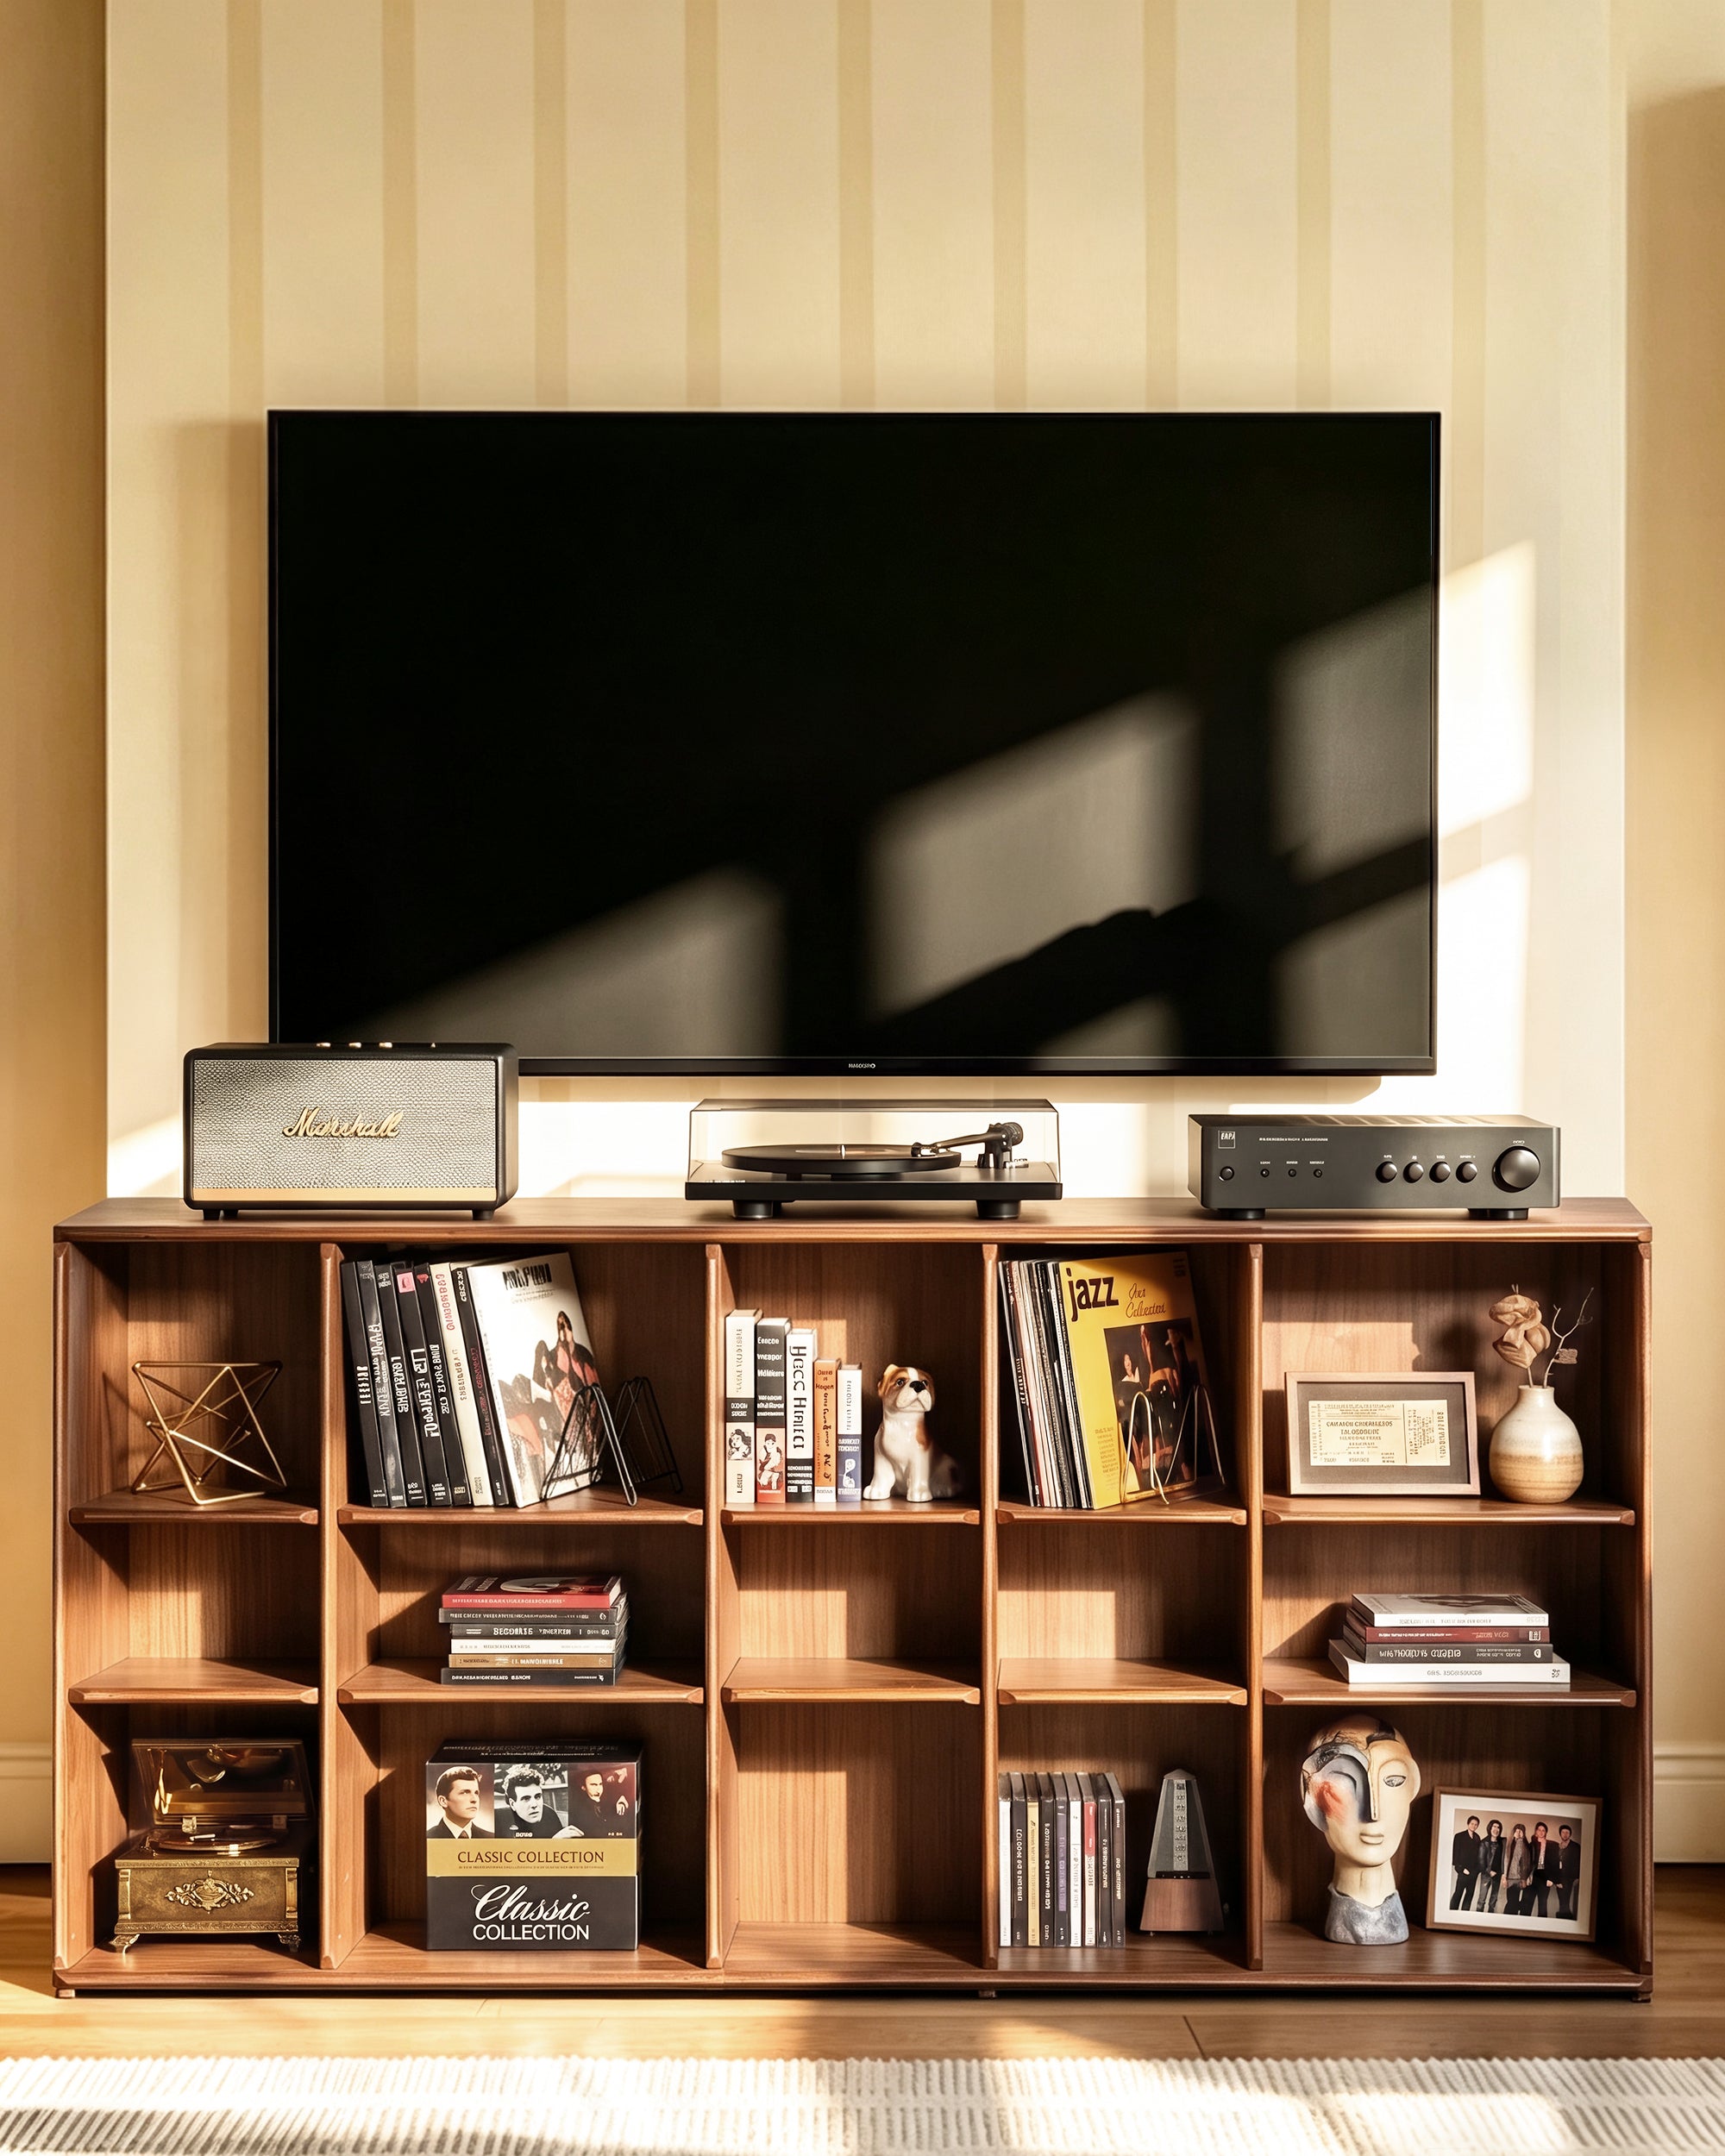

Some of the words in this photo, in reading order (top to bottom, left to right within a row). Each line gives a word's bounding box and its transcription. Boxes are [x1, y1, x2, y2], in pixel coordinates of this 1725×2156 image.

[282, 1106, 404, 1138] Marshall
[1065, 1267, 1120, 1322] jazz
[457, 1851, 513, 1864] CLASSIC
[517, 1851, 605, 1864] COLLECTION
[470, 1884, 591, 1921] Classic
[473, 1924, 590, 1940] COLLECTION
